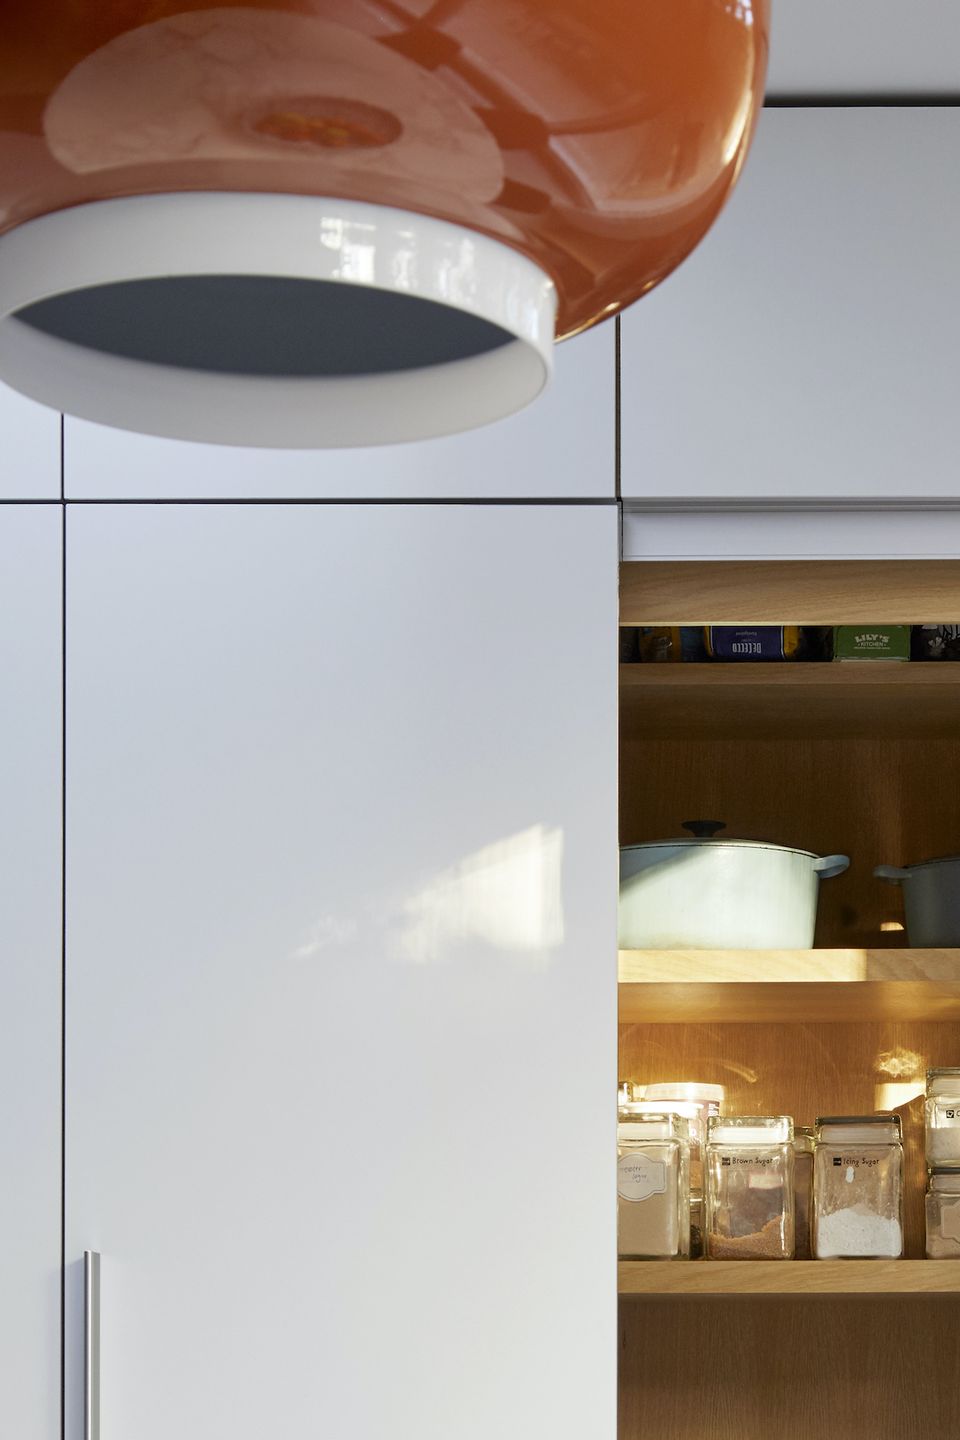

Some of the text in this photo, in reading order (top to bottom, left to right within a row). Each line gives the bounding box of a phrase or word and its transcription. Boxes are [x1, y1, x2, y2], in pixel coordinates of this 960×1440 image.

[854, 633, 890, 643] LILY'S
[755, 1156, 774, 1166] Sugar
[843, 1156, 880, 1167] Icing Sugar
